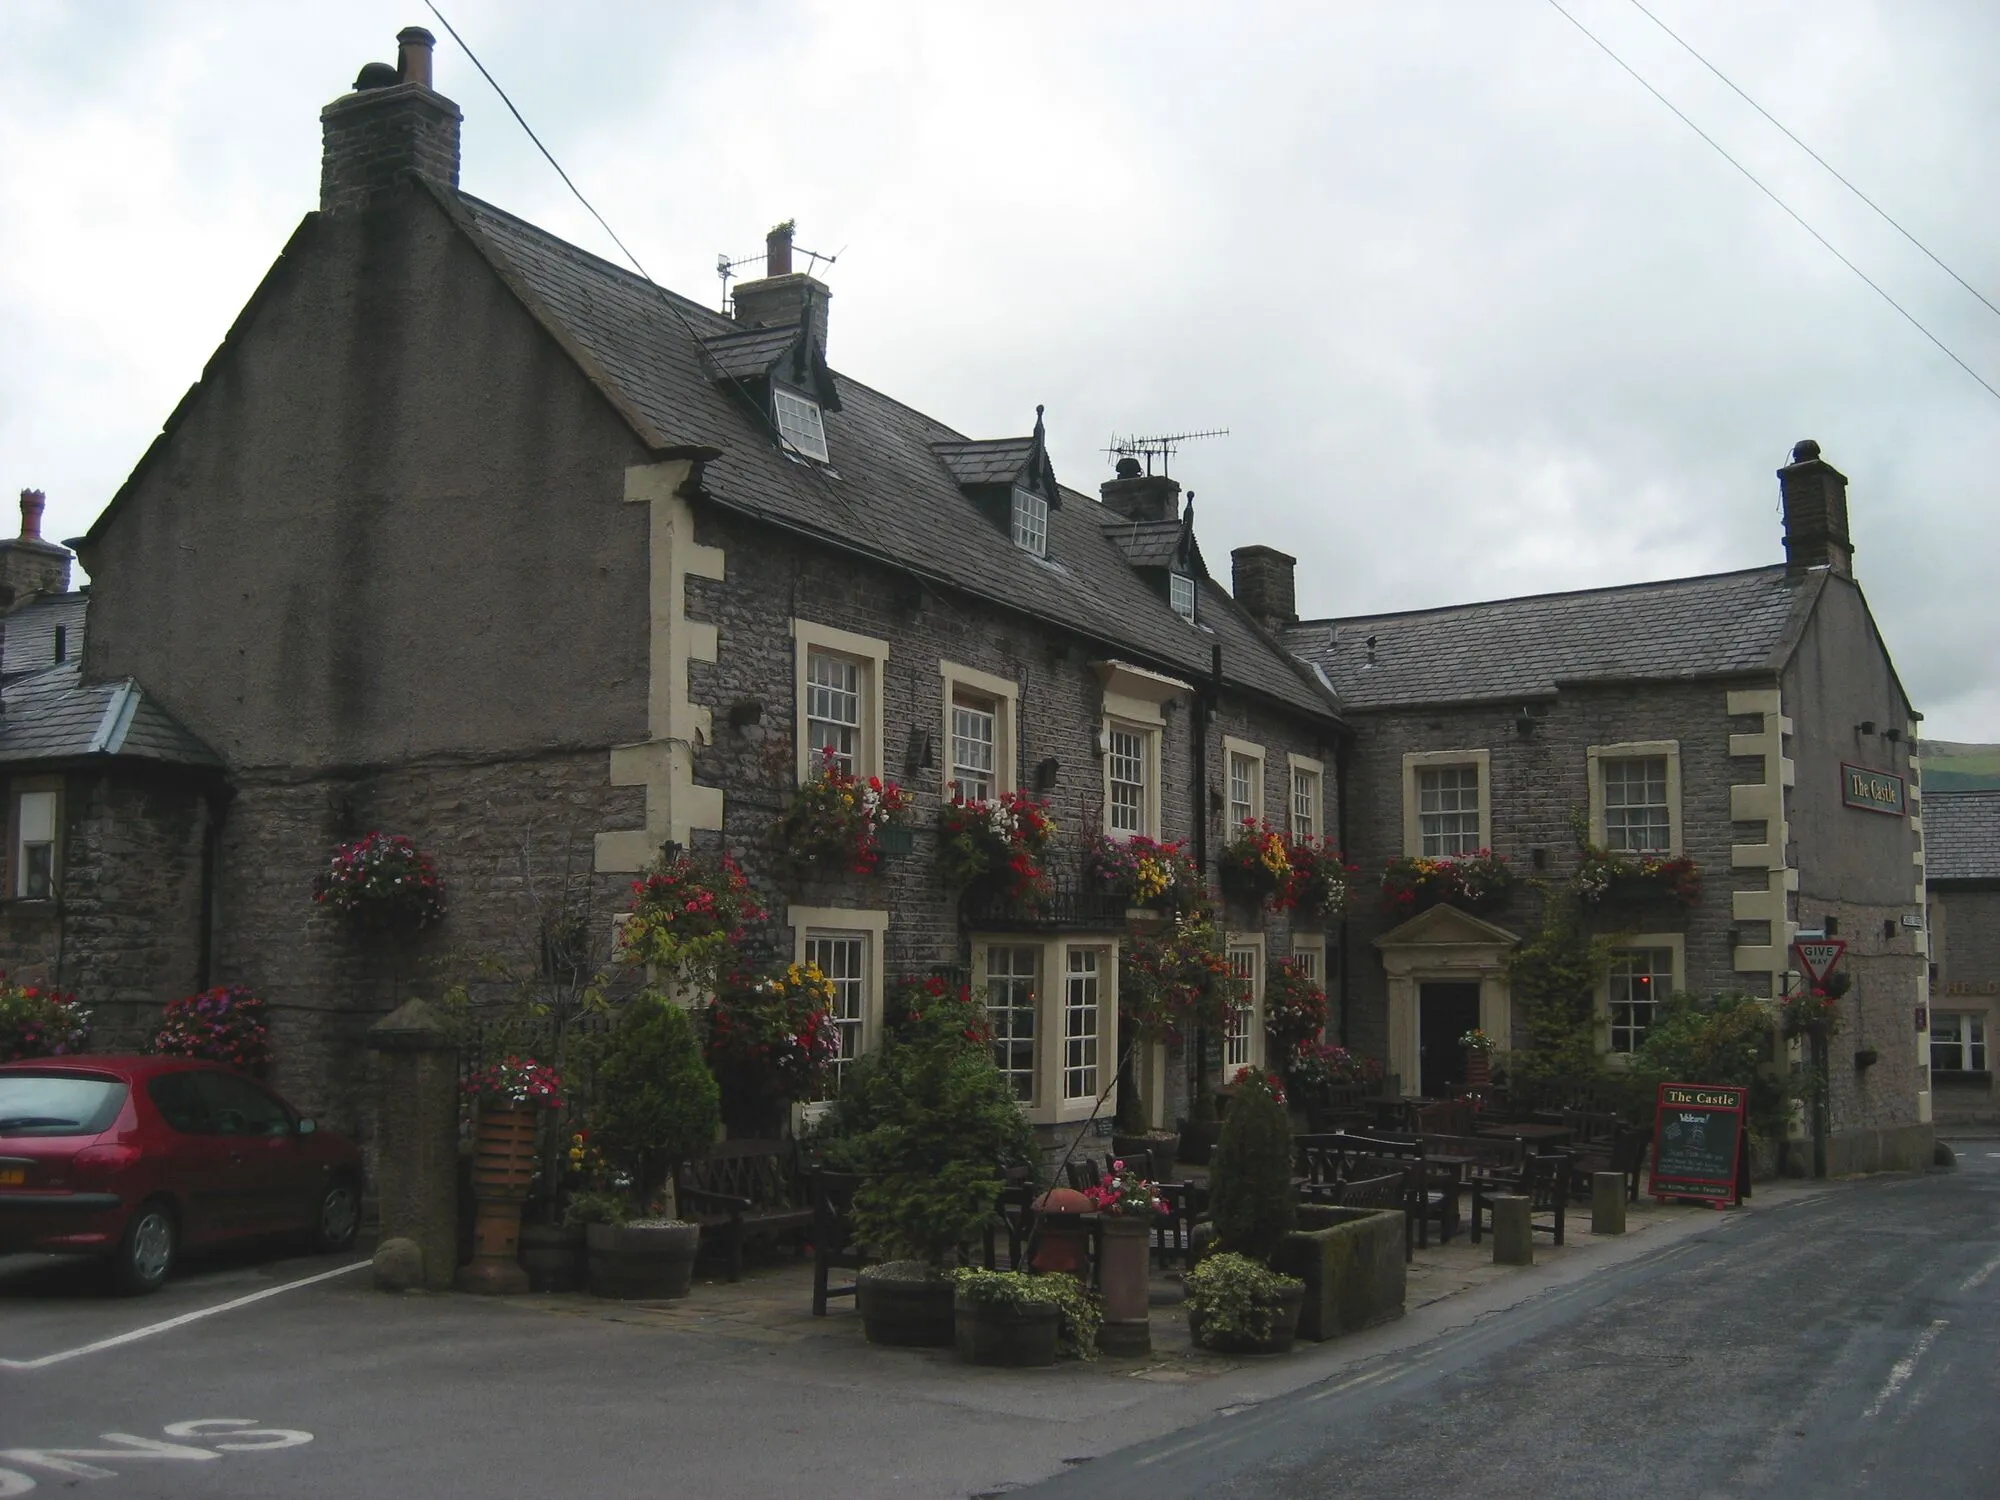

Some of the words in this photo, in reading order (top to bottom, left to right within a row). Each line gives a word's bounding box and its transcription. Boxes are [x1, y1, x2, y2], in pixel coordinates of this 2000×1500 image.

[1852, 774, 1869, 797] The
[1870, 779, 1896, 804] Castle
[1804, 946, 1833, 956] GIVE
[1669, 1091, 1692, 1103] The
[1696, 1093, 1734, 1105] Castle
[0, 1418, 314, 1498] NS
